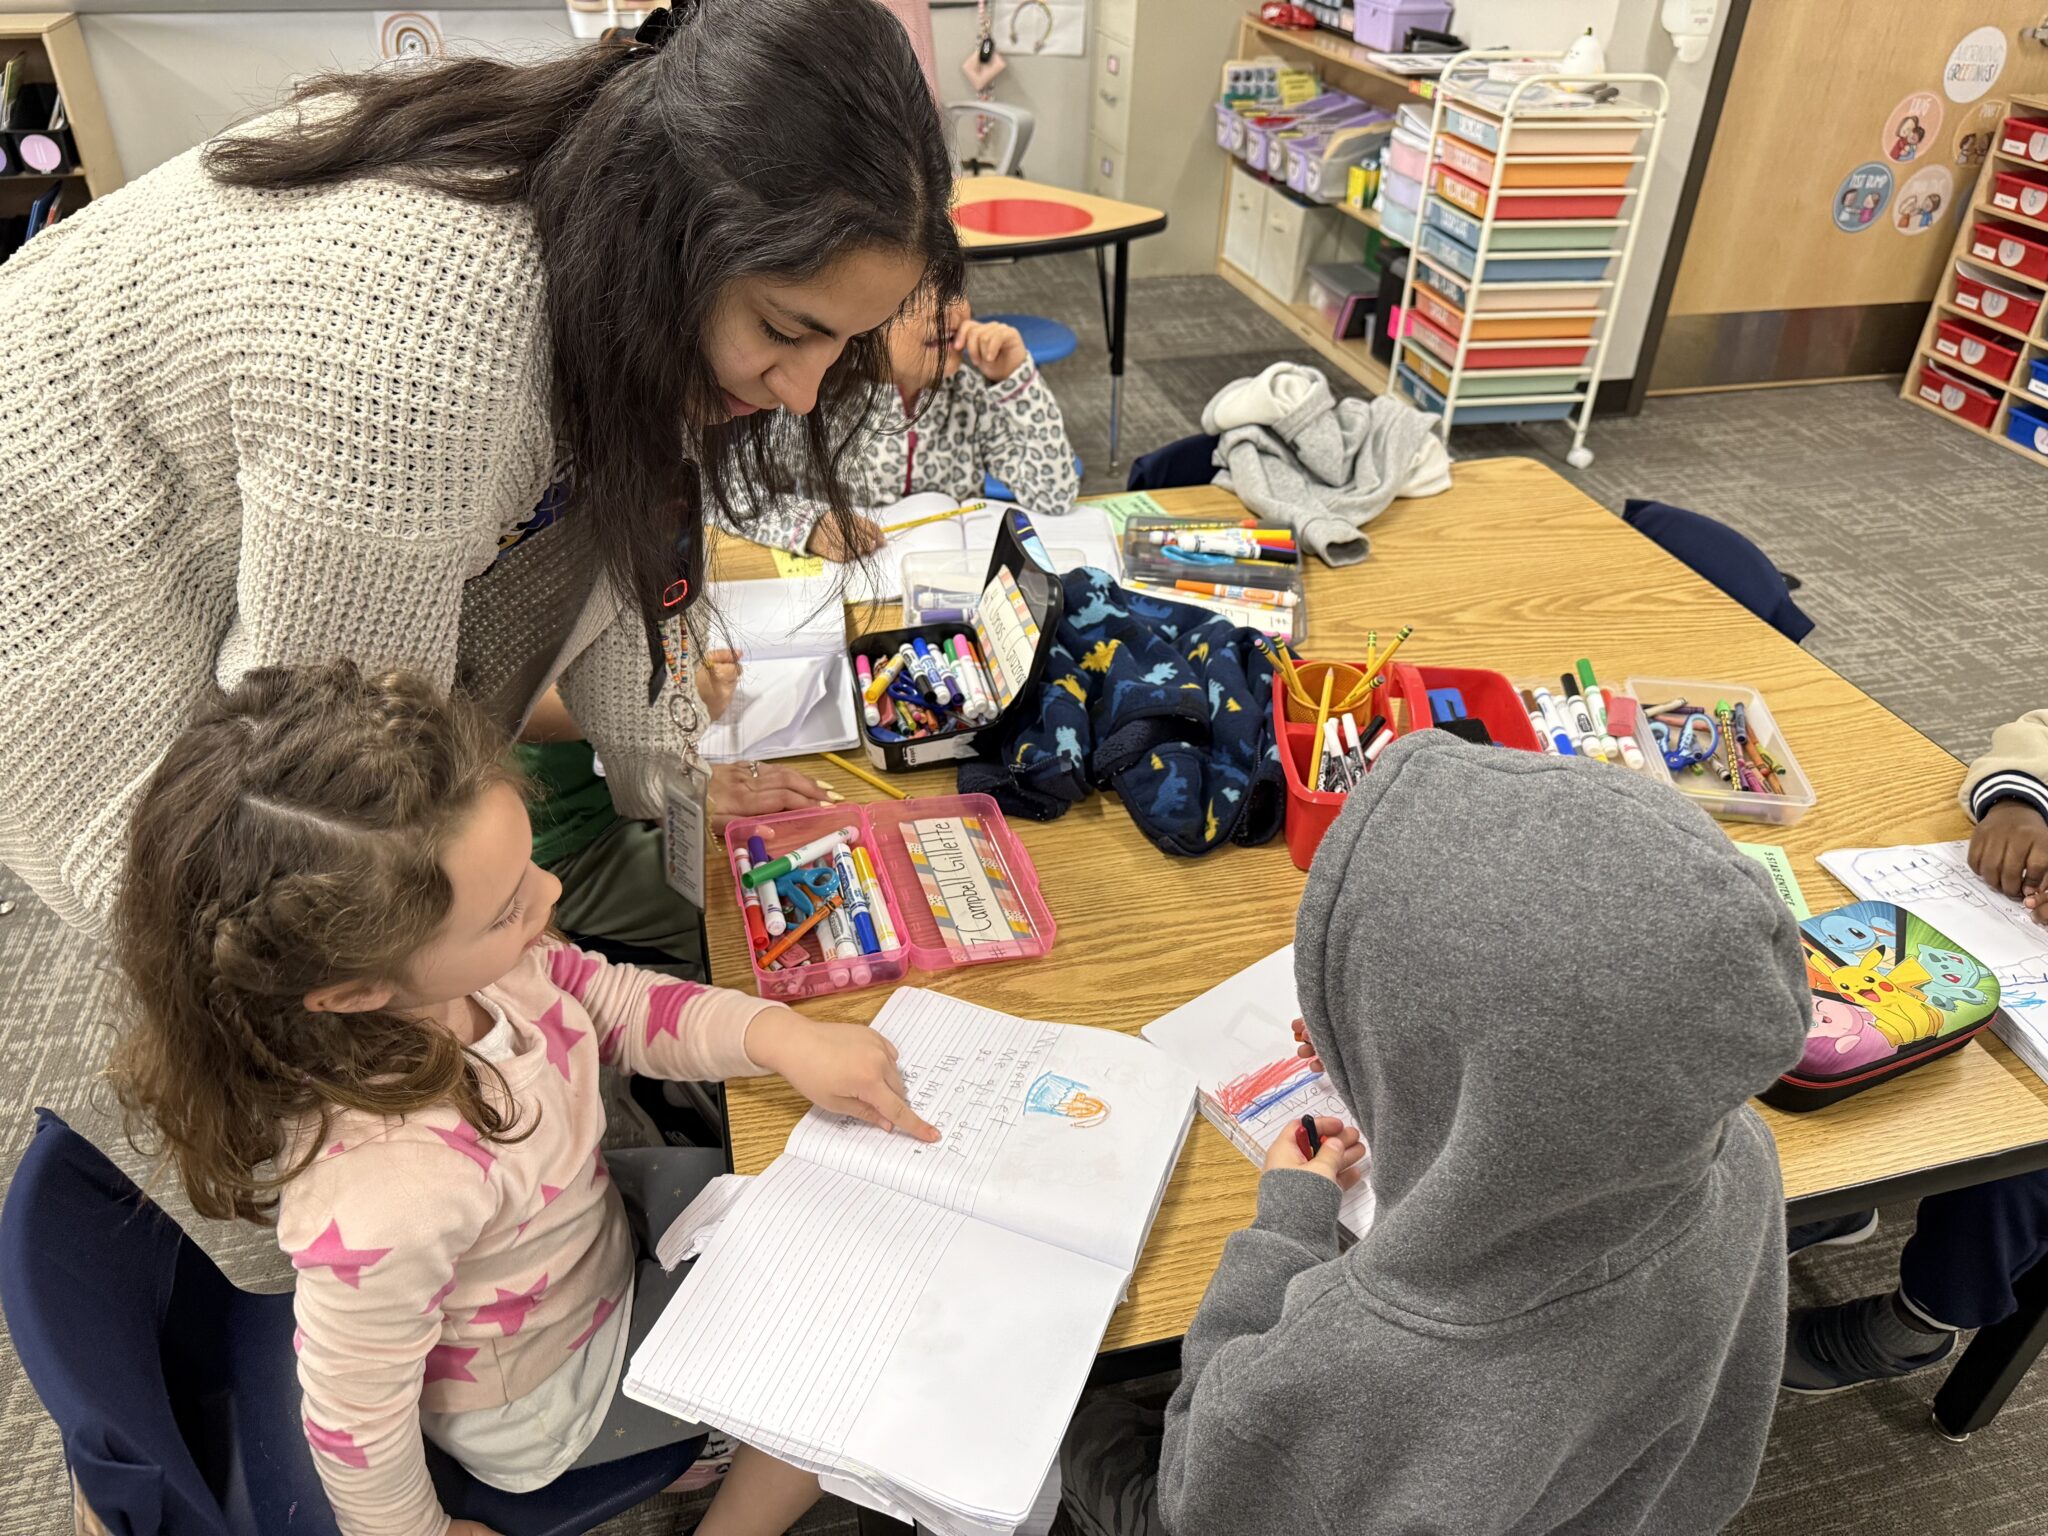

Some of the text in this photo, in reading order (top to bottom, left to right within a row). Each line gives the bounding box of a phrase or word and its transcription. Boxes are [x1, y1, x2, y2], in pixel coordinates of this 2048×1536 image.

[917, 821, 966, 873] Gillette
[1767, 857, 1780, 872] STAR
[938, 876, 992, 933] Campbell
